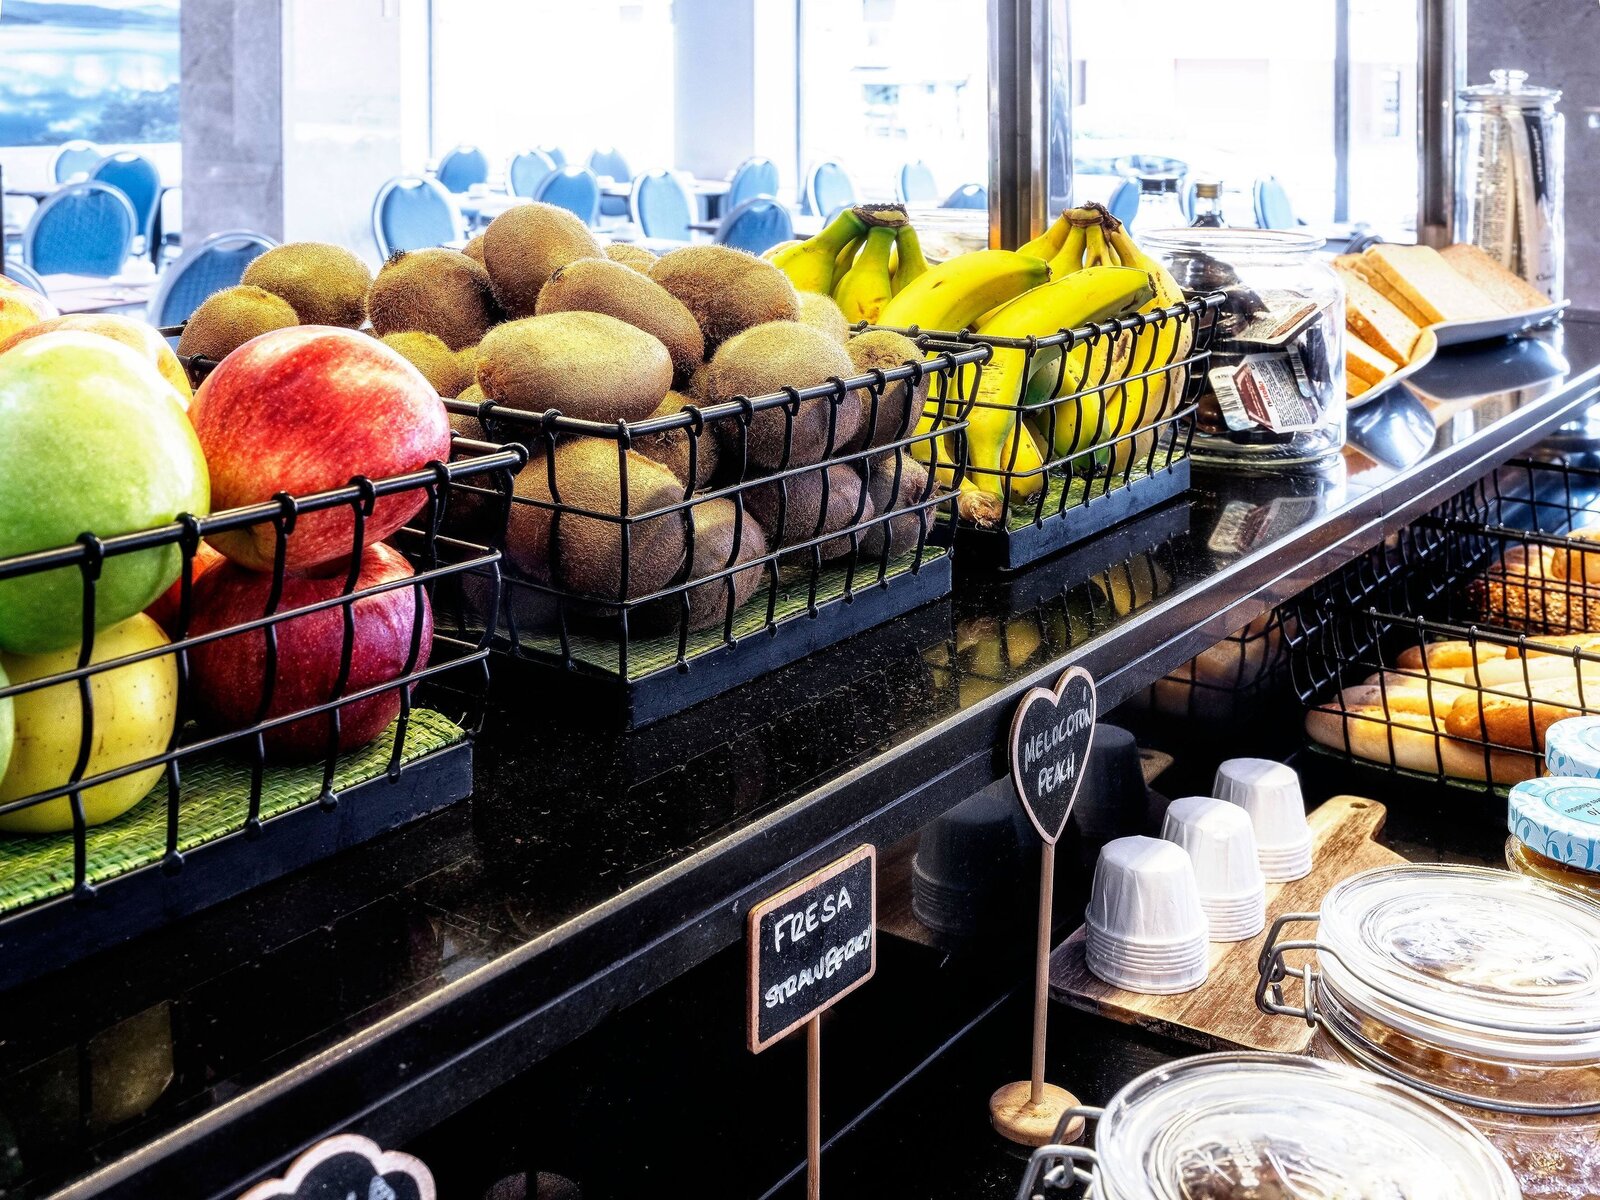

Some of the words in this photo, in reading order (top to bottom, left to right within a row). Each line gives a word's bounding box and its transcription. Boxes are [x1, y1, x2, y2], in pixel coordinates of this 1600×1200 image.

[1038, 752, 1075, 797] PEACH
[774, 886, 852, 953] FRESA
[765, 924, 872, 1009] STRAWBERRY
